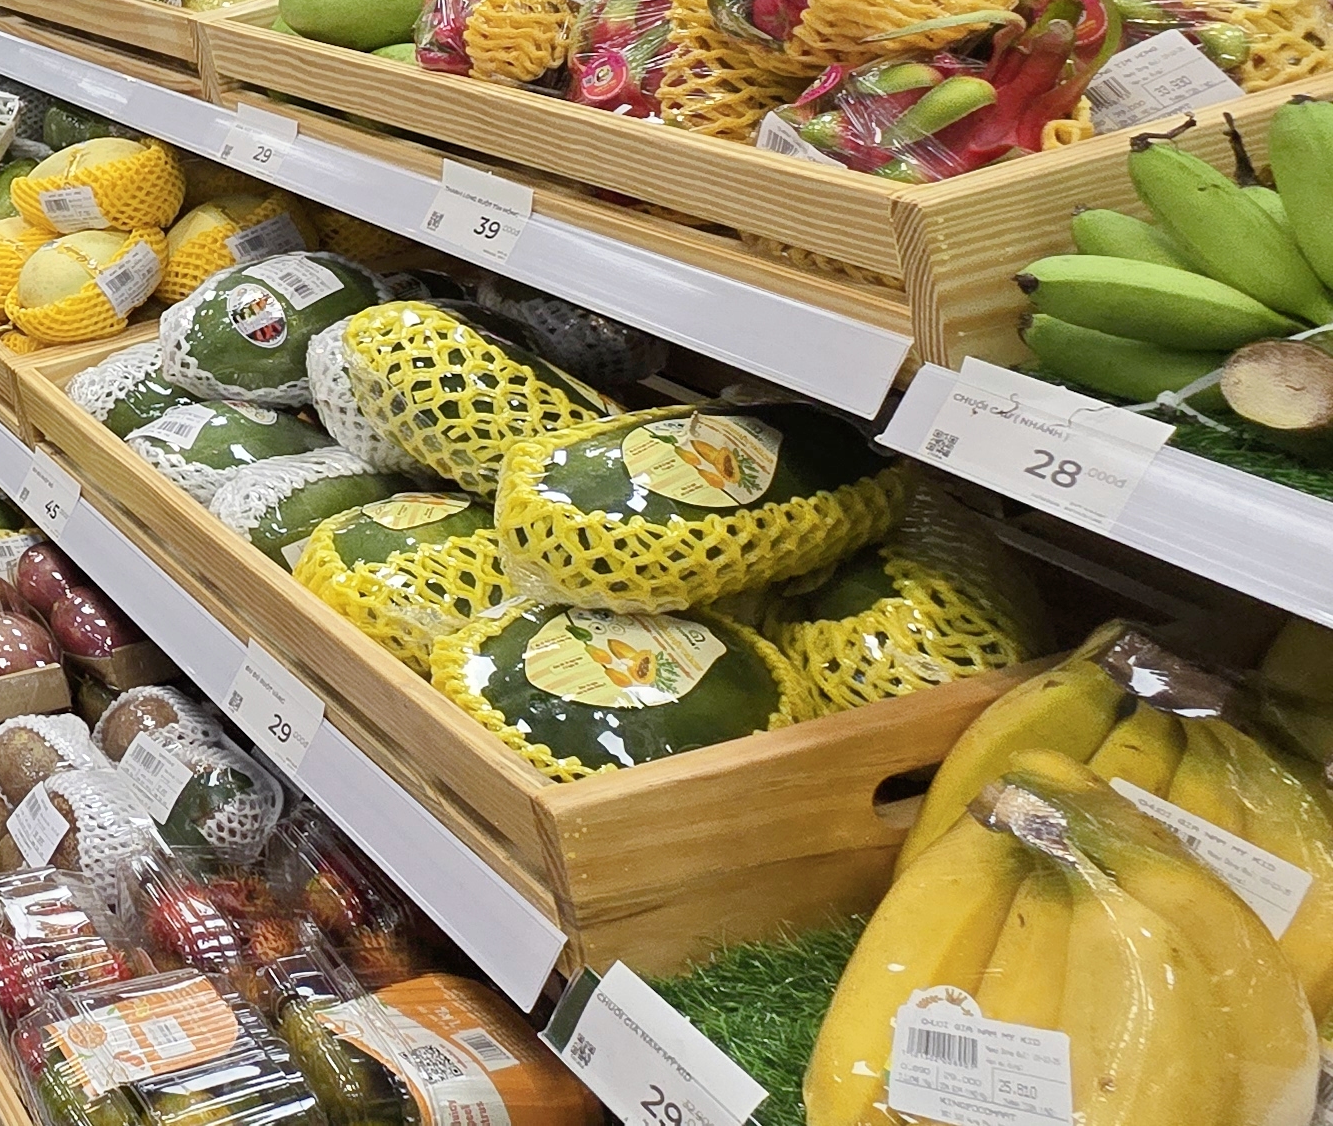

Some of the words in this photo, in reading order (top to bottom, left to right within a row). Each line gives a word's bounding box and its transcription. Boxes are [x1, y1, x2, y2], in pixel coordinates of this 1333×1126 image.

[253, 146, 272, 164] 29
[473, 216, 501, 239] 39
[1023, 449, 1082, 489] 28
[45, 500, 61, 519] 45
[268, 715, 292, 743] 29
